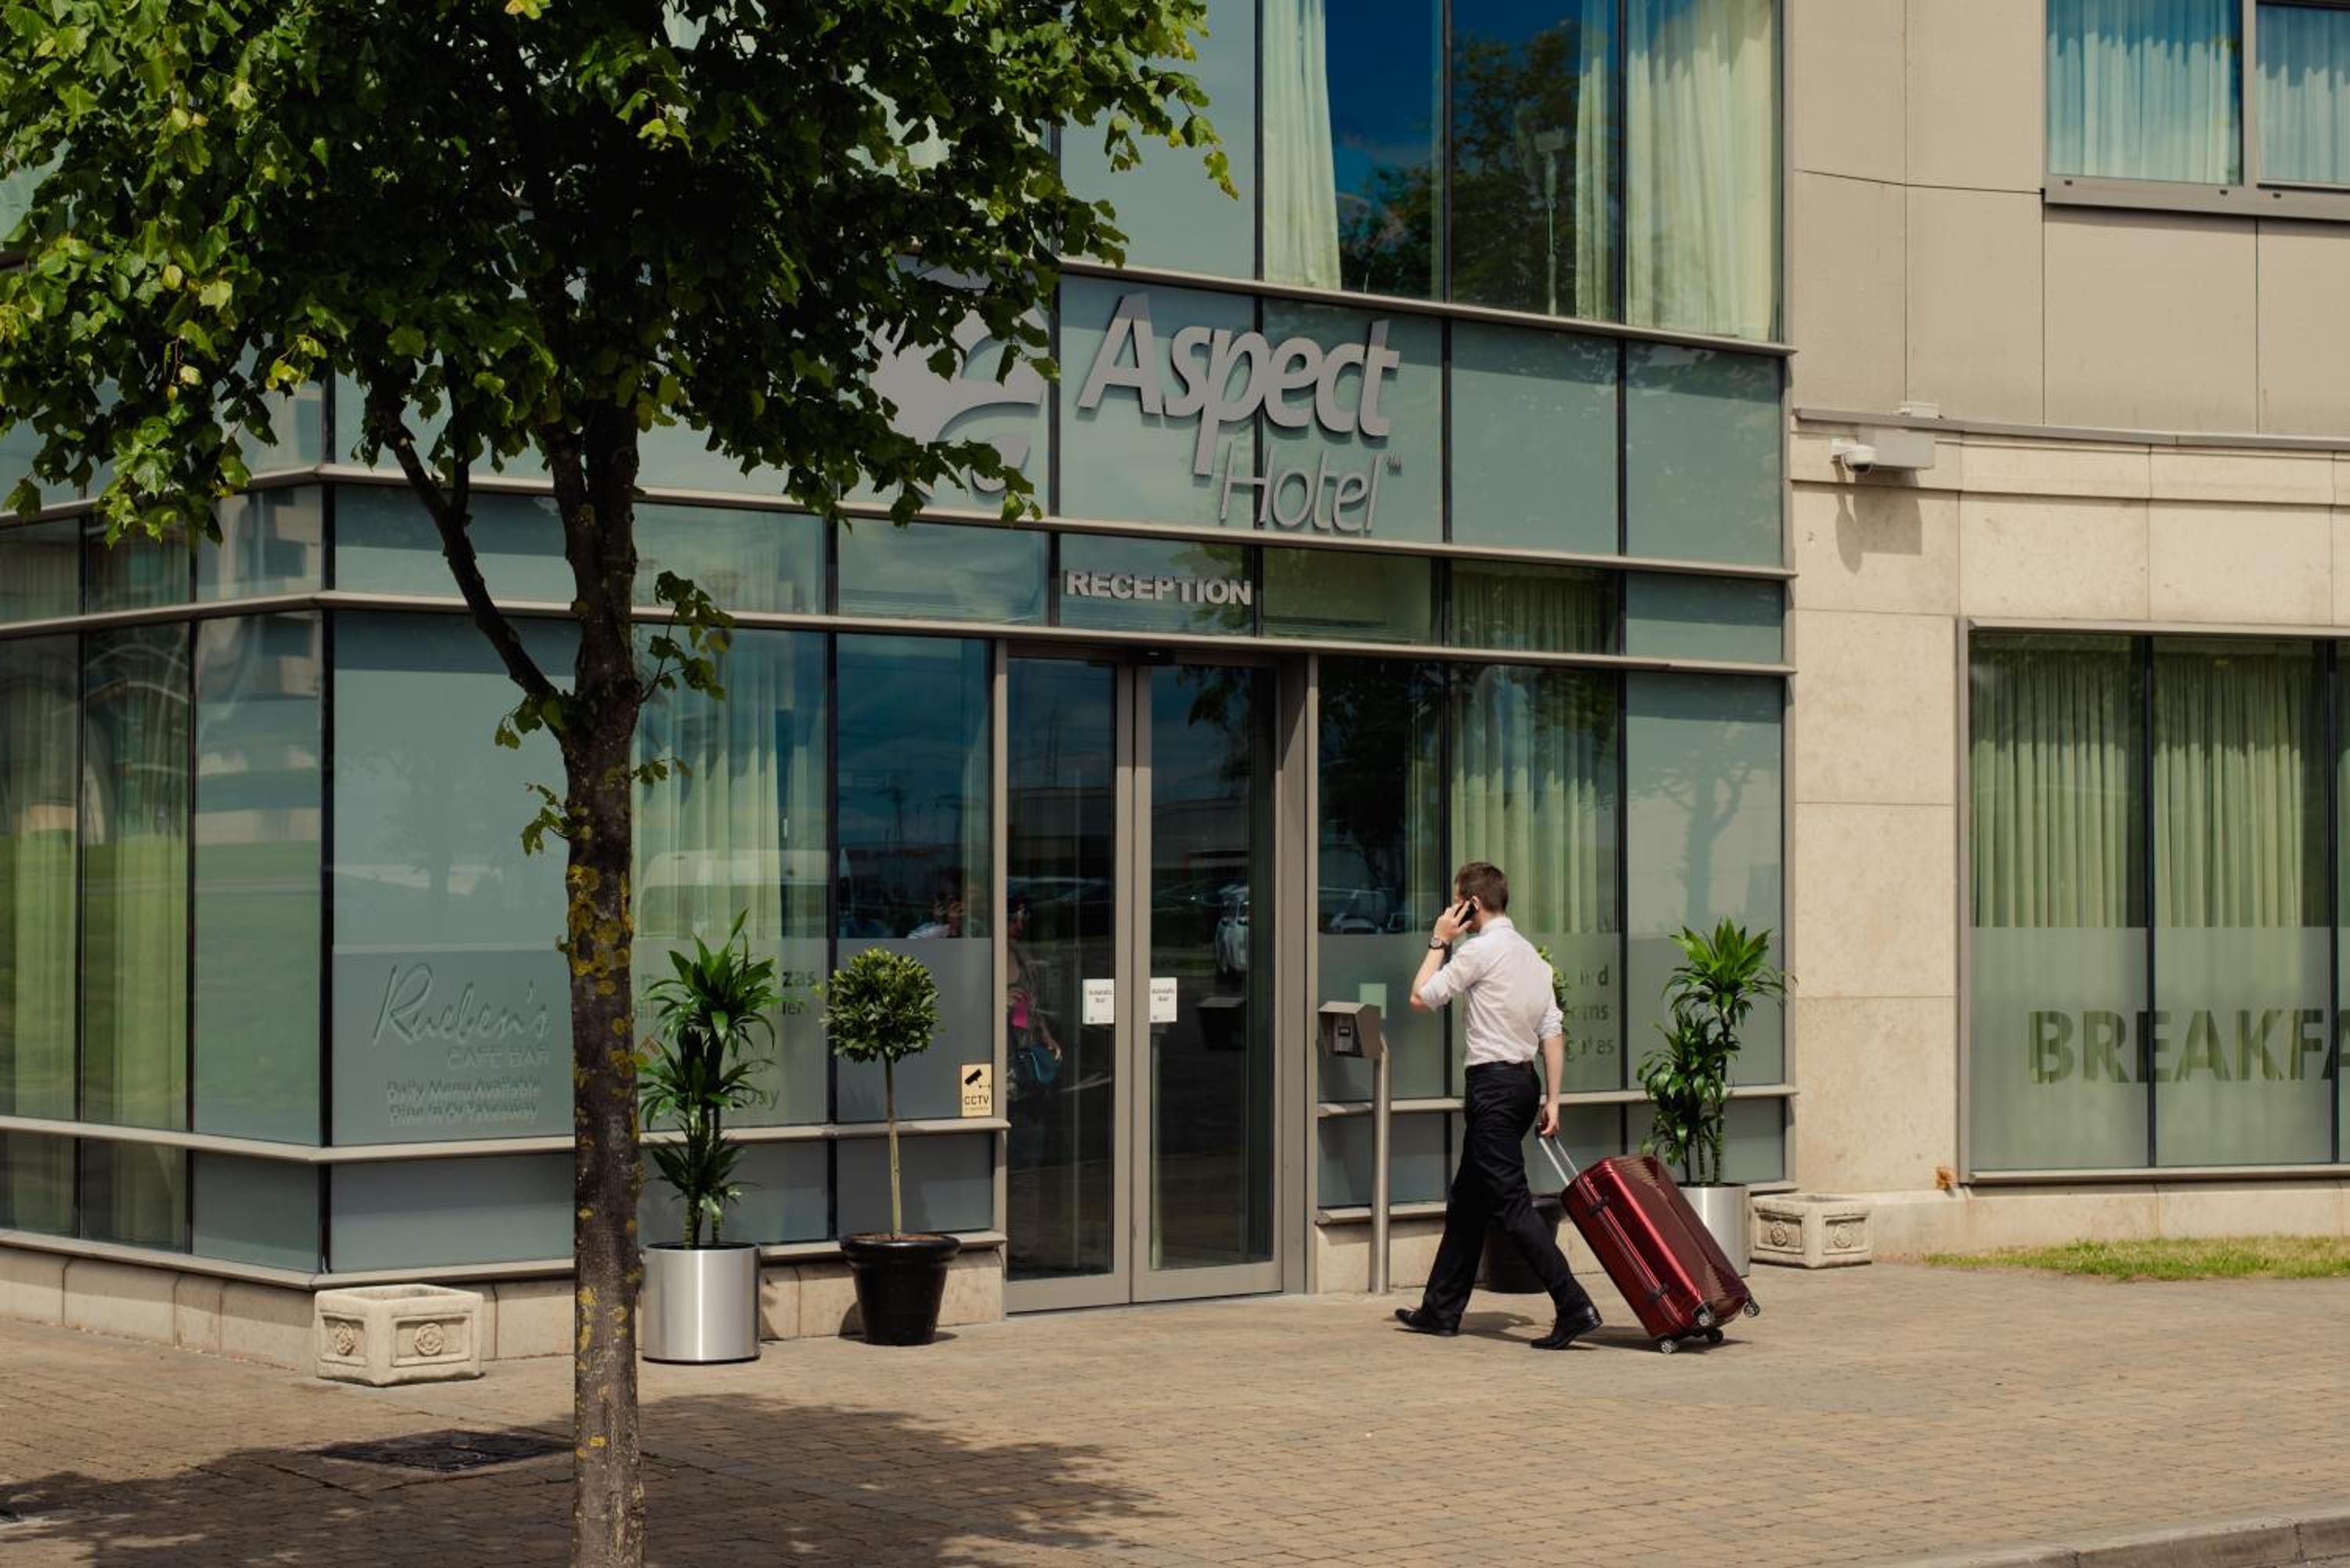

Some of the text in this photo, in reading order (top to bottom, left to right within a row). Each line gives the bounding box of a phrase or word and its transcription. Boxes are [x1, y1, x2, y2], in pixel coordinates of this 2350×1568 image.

[1077, 292, 1400, 475] Aspect
[1220, 441, 1384, 533] Hotel
[1065, 569, 1252, 605] RECEPTION
[964, 1095, 989, 1105] CCTV
